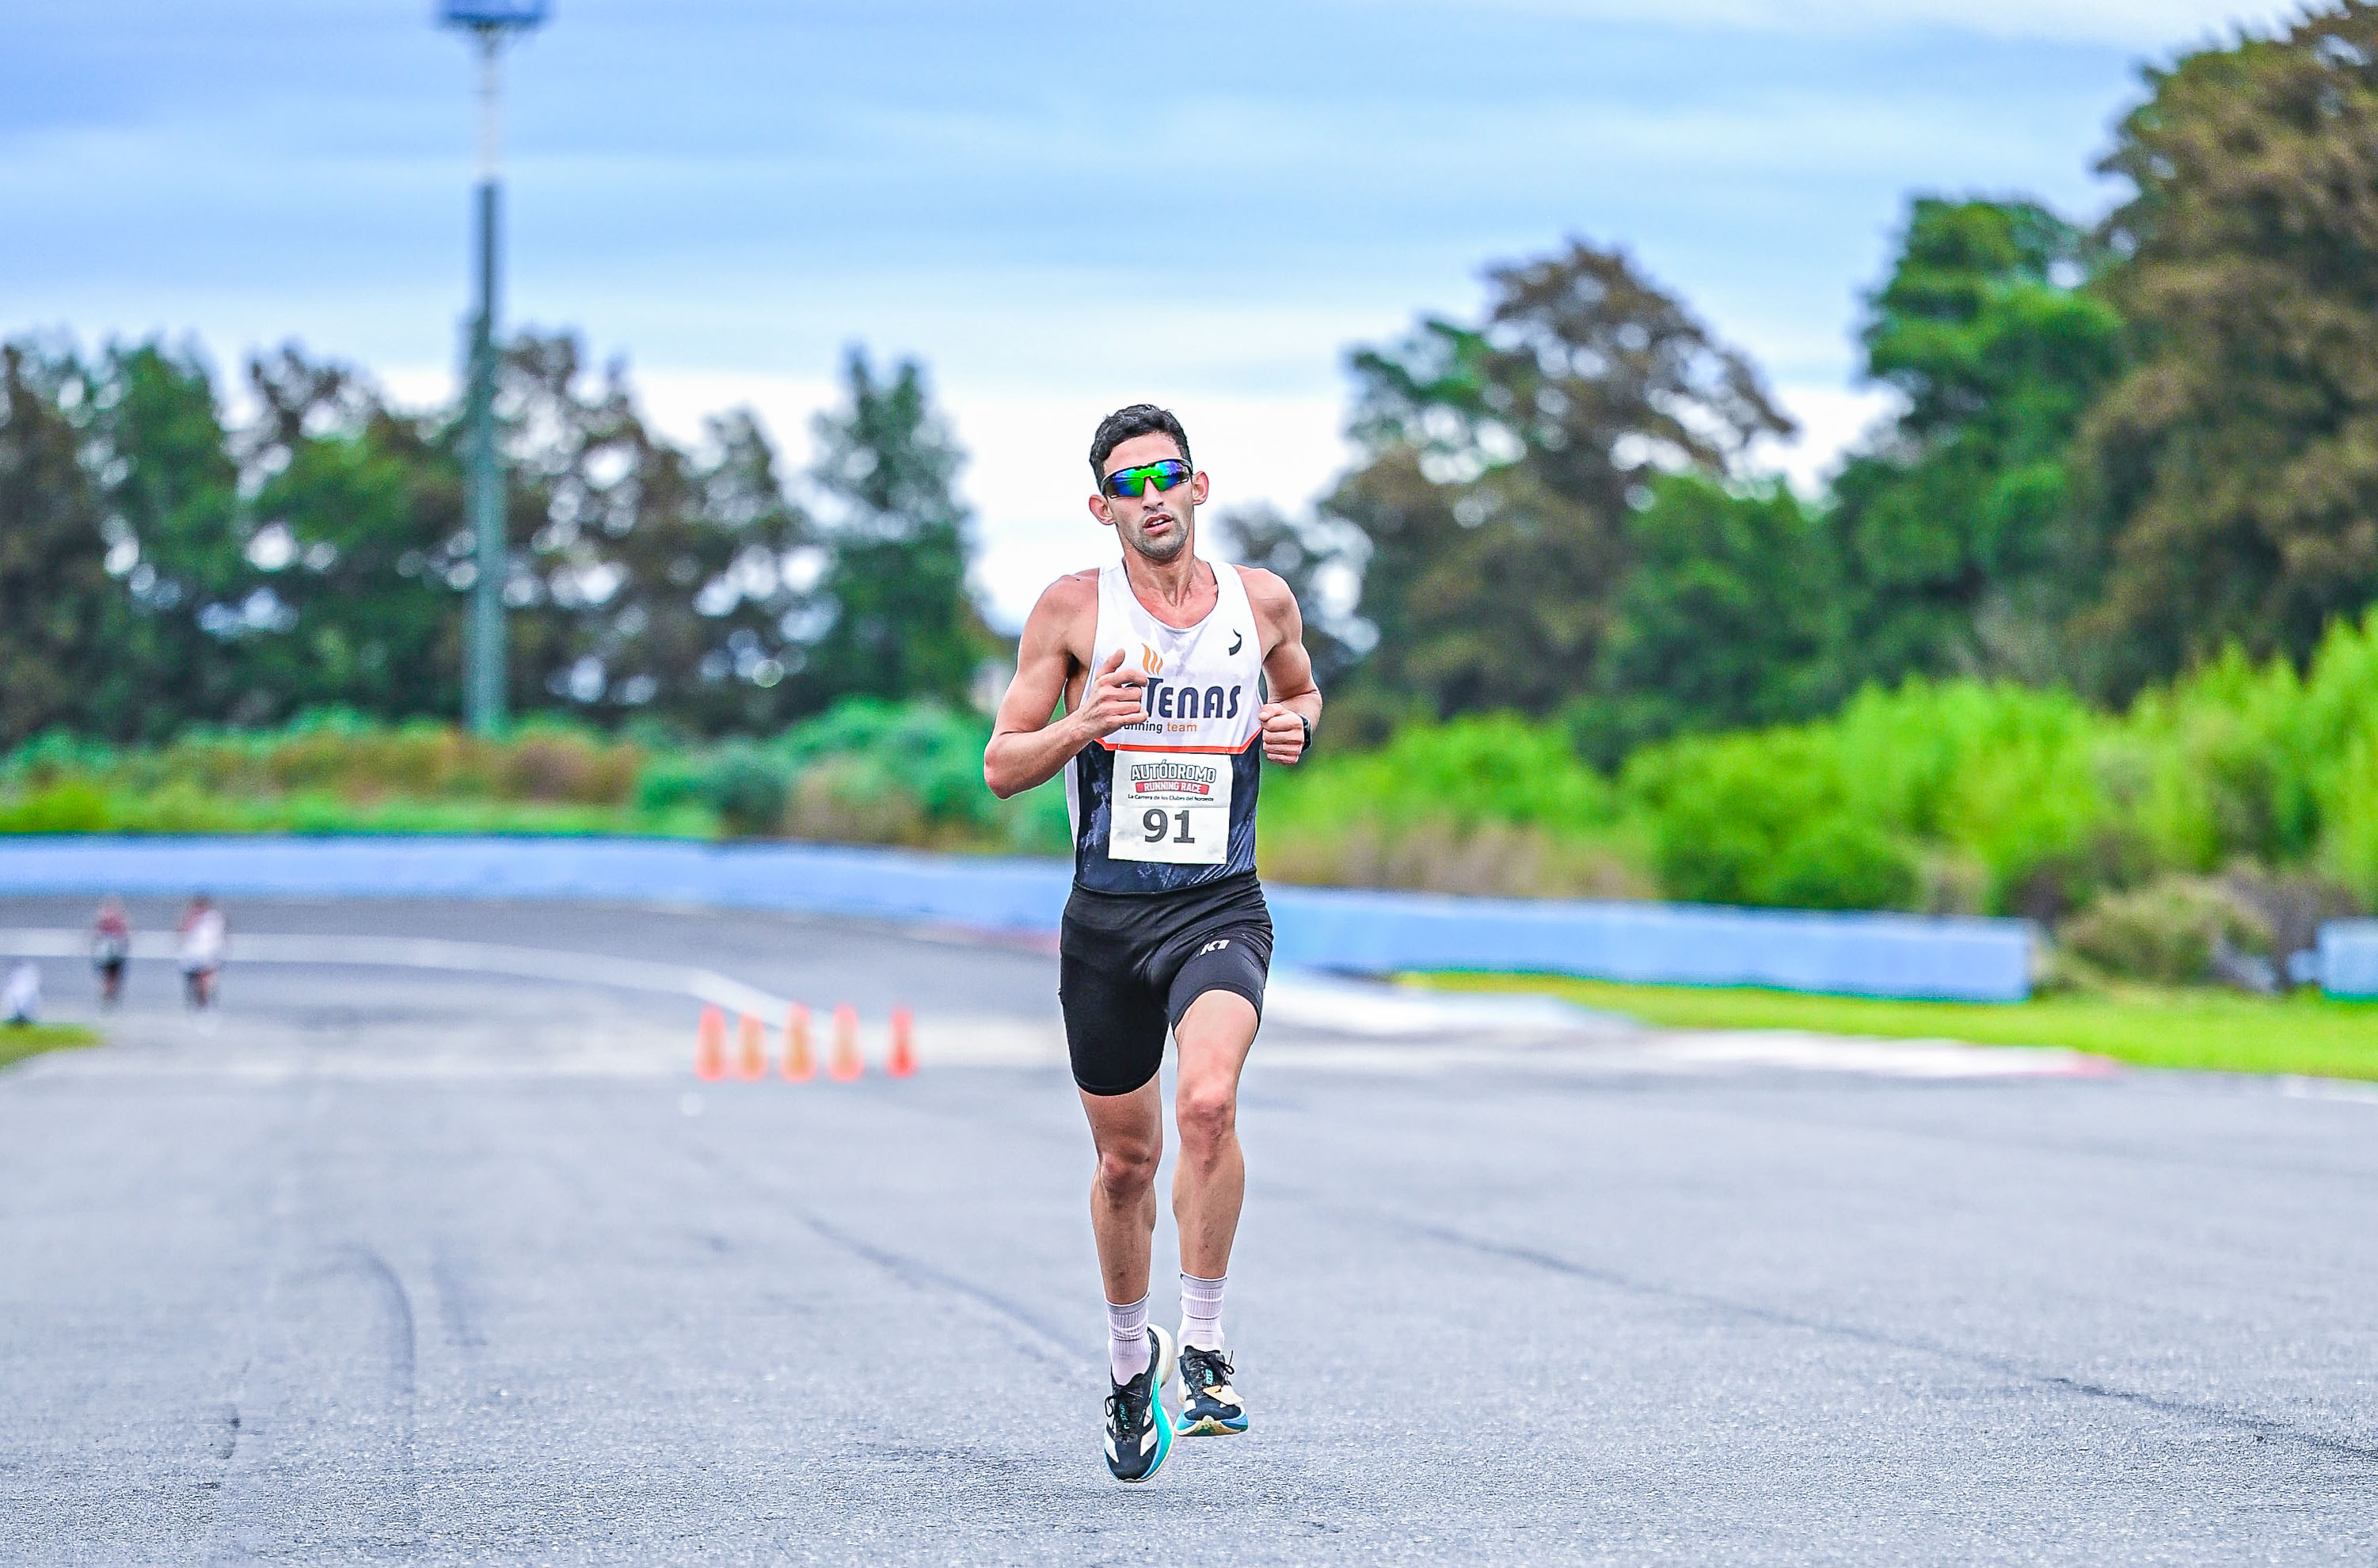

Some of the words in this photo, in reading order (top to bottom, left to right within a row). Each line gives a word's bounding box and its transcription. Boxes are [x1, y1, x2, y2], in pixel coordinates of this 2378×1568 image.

[1124, 677, 1242, 719] TENAS
[1166, 721, 1197, 732] team
[1131, 759, 1216, 783] AUTÓDROMO
[1144, 781, 1179, 792] RUNNING
[1181, 783, 1201, 793] RACE
[1143, 809, 1195, 843] 91
